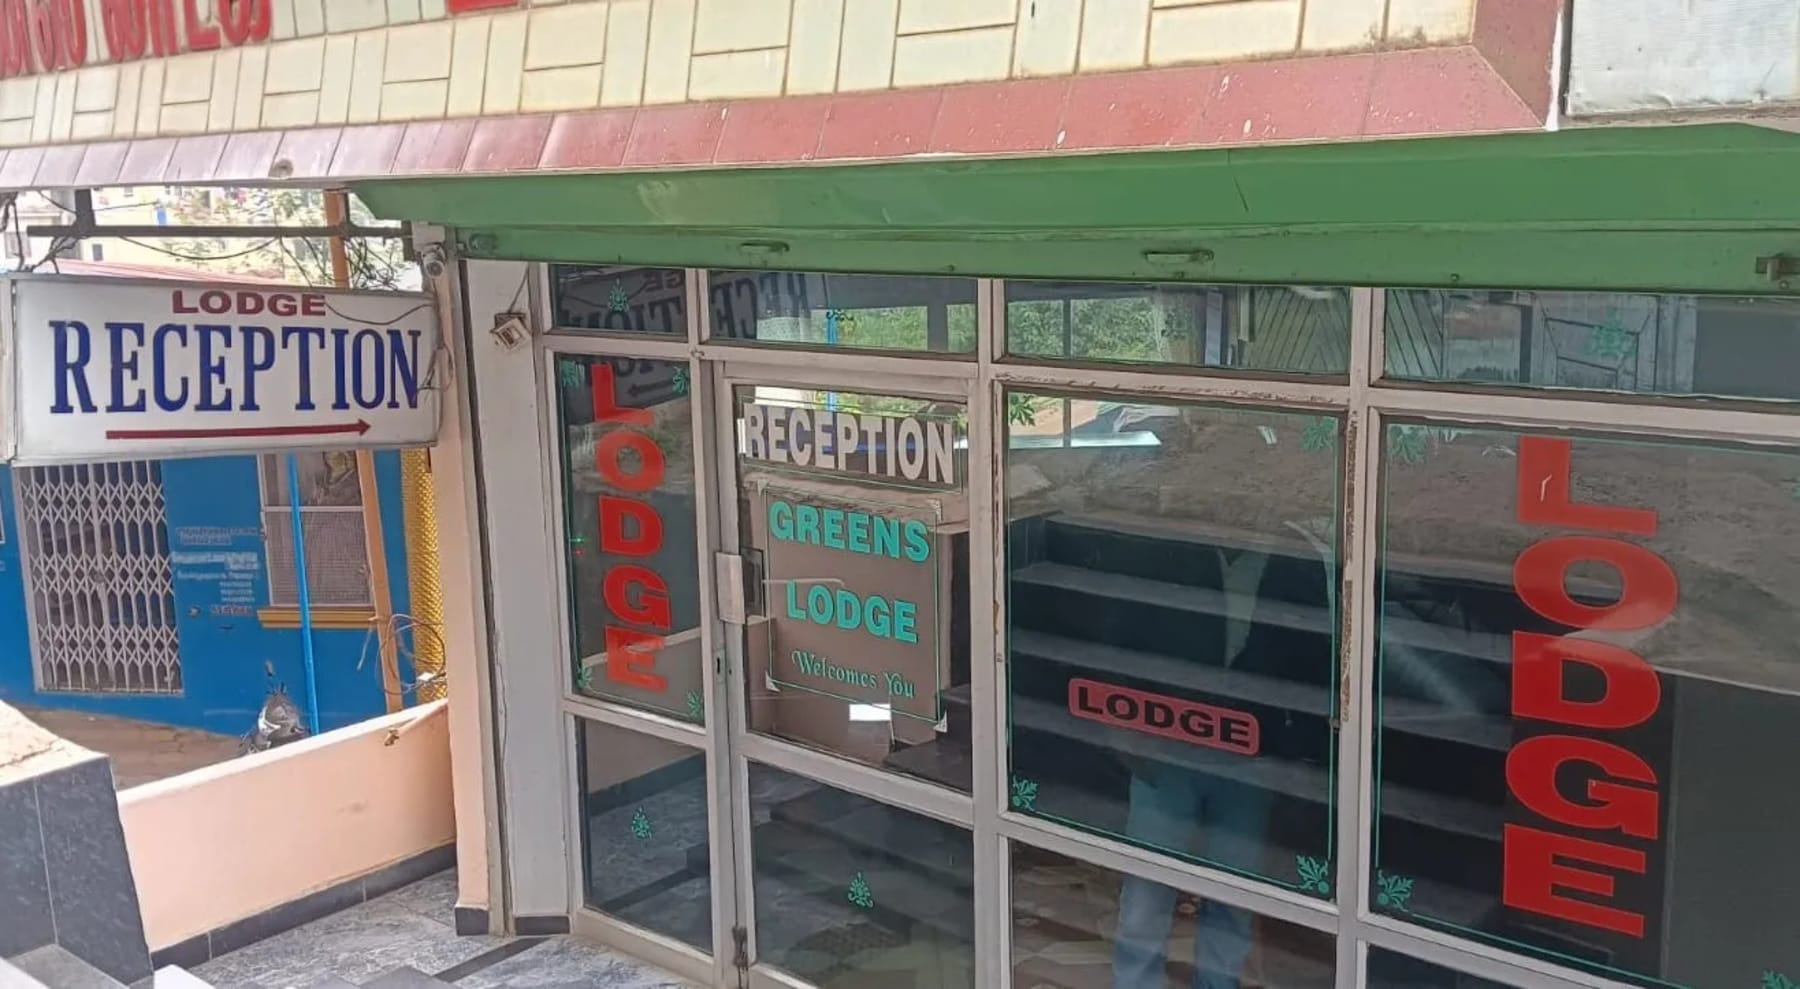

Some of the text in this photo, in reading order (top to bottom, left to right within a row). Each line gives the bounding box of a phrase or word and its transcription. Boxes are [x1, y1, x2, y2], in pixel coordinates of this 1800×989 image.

[172, 290, 326, 316] LODGE
[49, 320, 421, 413] RECEPTION
[744, 403, 953, 484] RECEPTION
[591, 362, 671, 692] LODGE
[769, 501, 930, 563] GREENS
[786, 579, 918, 643] LODGE
[792, 650, 915, 698] Welcomes You
[1503, 435, 1679, 938] LODGE
[1077, 686, 1250, 747] LODGE
